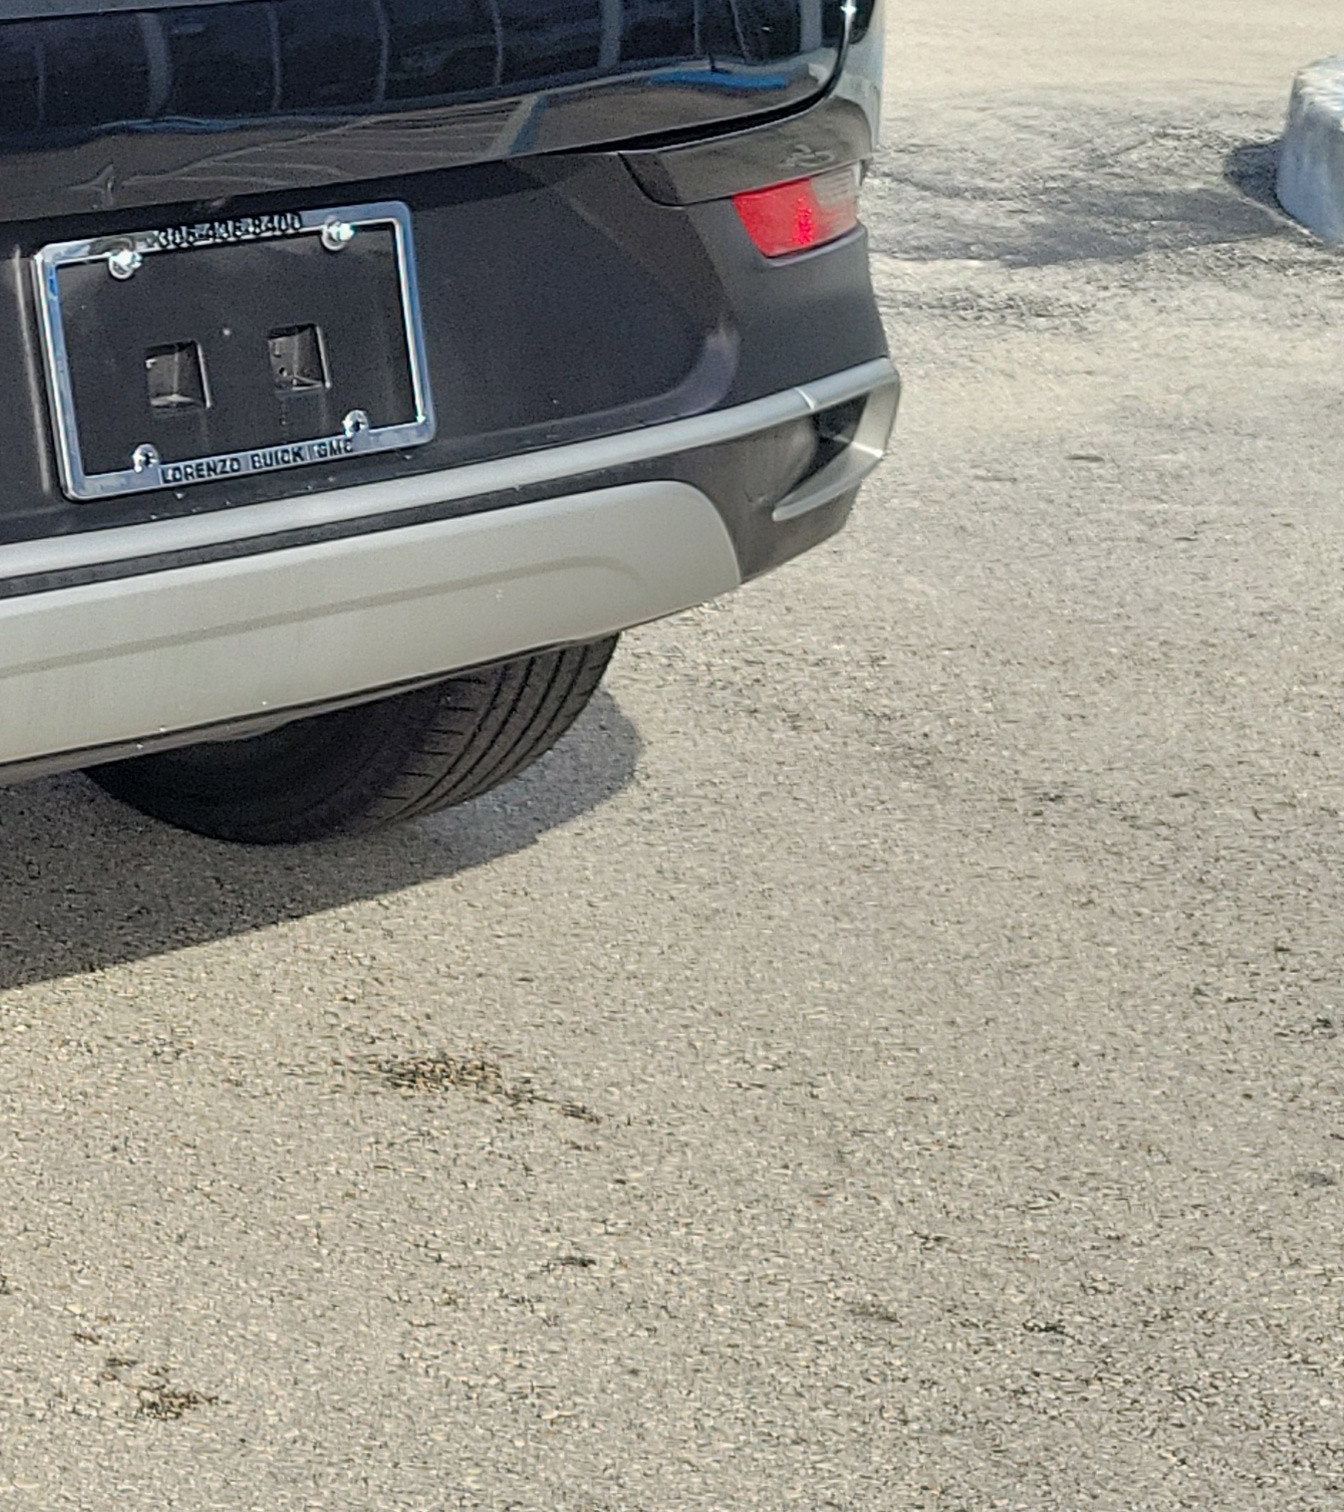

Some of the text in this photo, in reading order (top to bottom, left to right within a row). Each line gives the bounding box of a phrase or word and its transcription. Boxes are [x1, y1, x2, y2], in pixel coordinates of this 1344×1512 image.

[162, 437, 354, 484] LORENZO BUICK GMC
